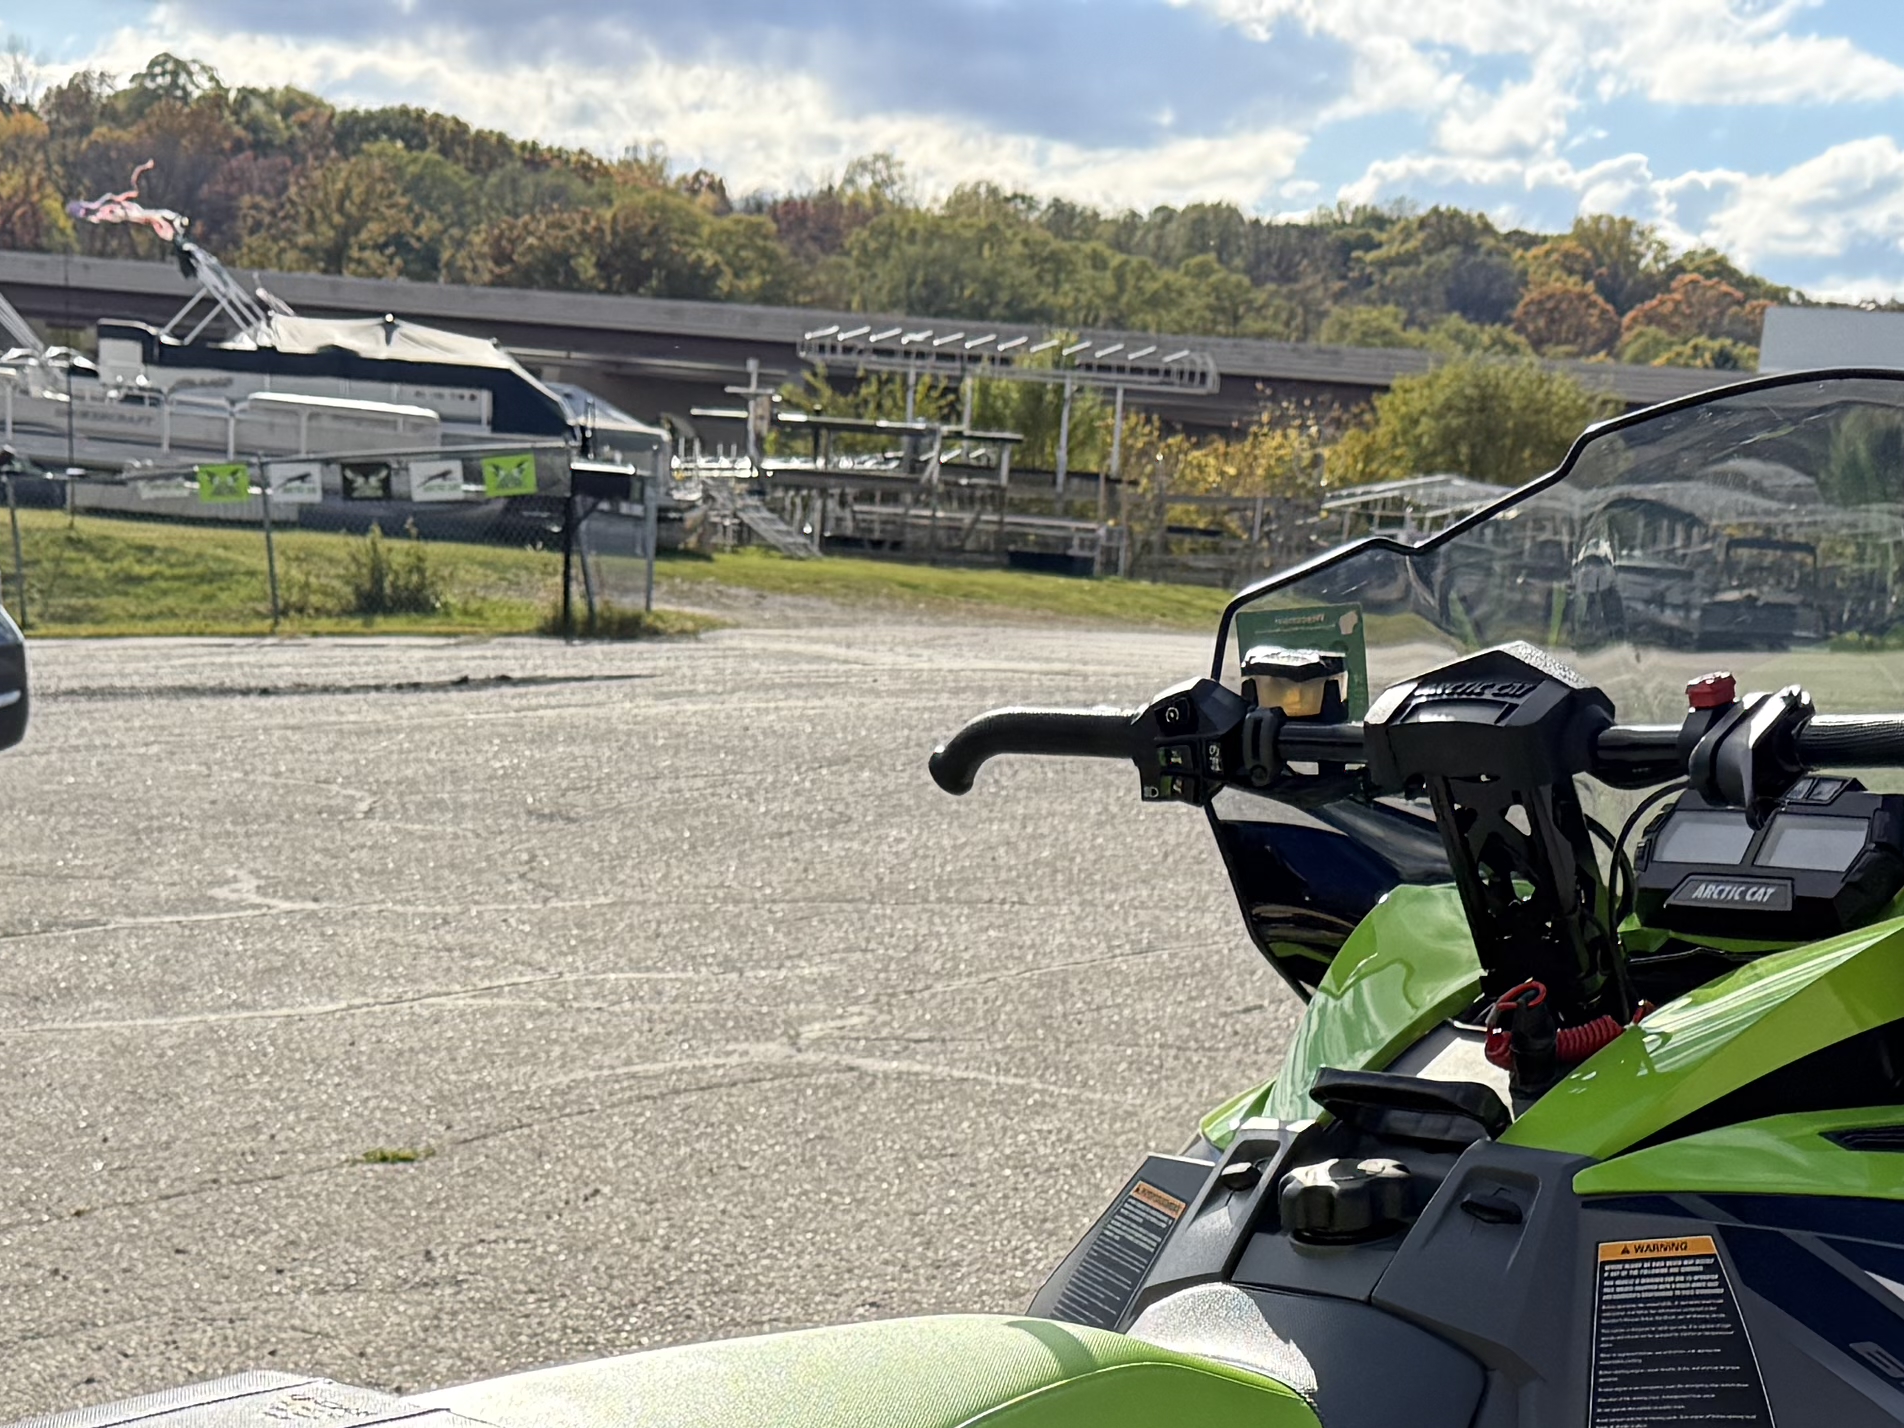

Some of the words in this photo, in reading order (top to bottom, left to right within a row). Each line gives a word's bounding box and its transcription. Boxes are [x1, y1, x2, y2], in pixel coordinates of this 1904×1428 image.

[1692, 882, 1746, 900] ARCTIC
[1745, 886, 1776, 903] CAT
[1634, 1241, 1688, 1254] WARNING
